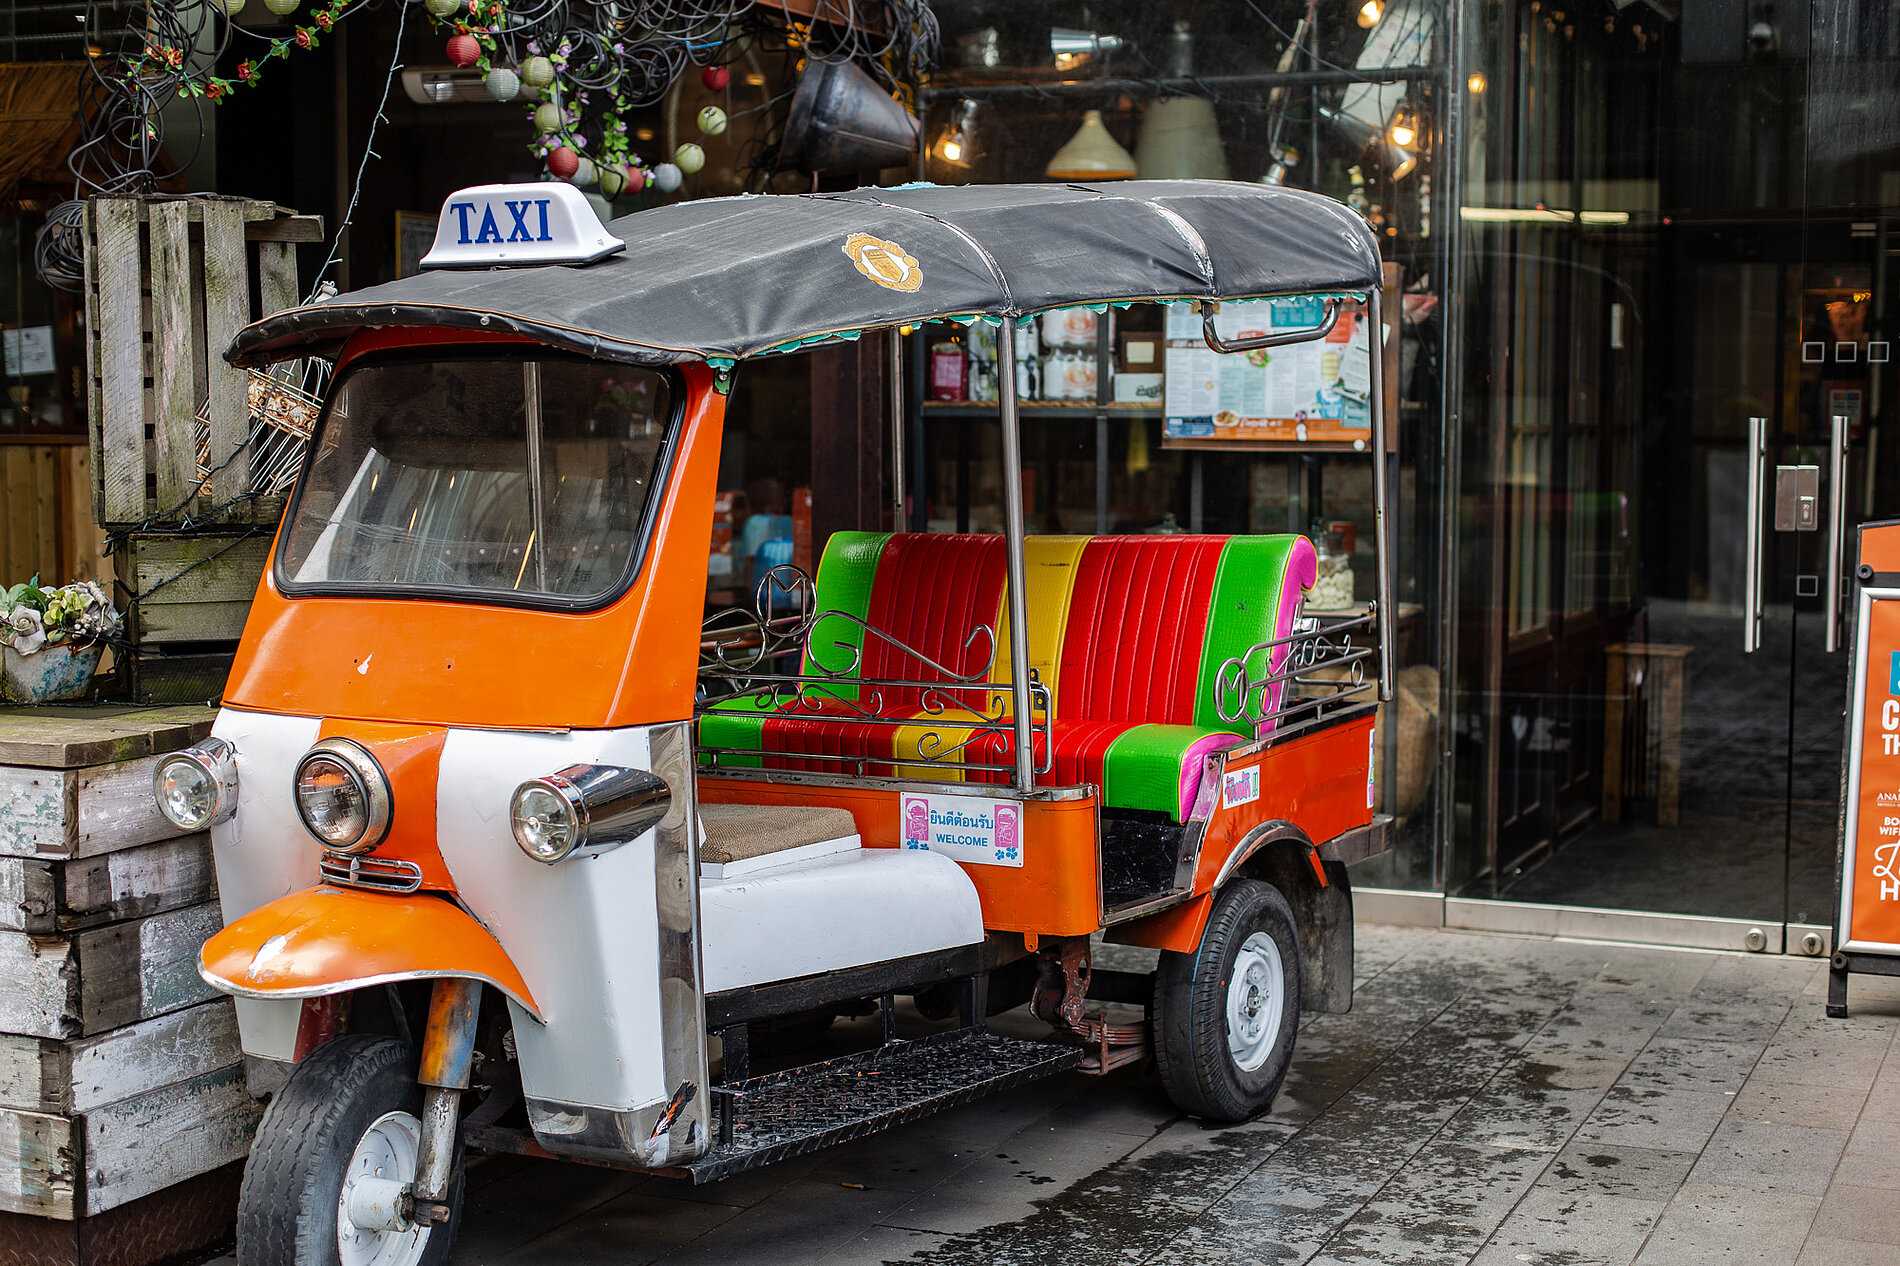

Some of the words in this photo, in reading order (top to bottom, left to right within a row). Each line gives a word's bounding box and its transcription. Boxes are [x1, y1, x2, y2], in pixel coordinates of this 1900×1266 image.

[450, 199, 553, 244] TAXI
[1877, 792, 1900, 801] ANA
[930, 809, 994, 830] ยินดีต้อนรับ
[1879, 826, 1900, 836] WIF
[936, 833, 988, 847] WELCOME
